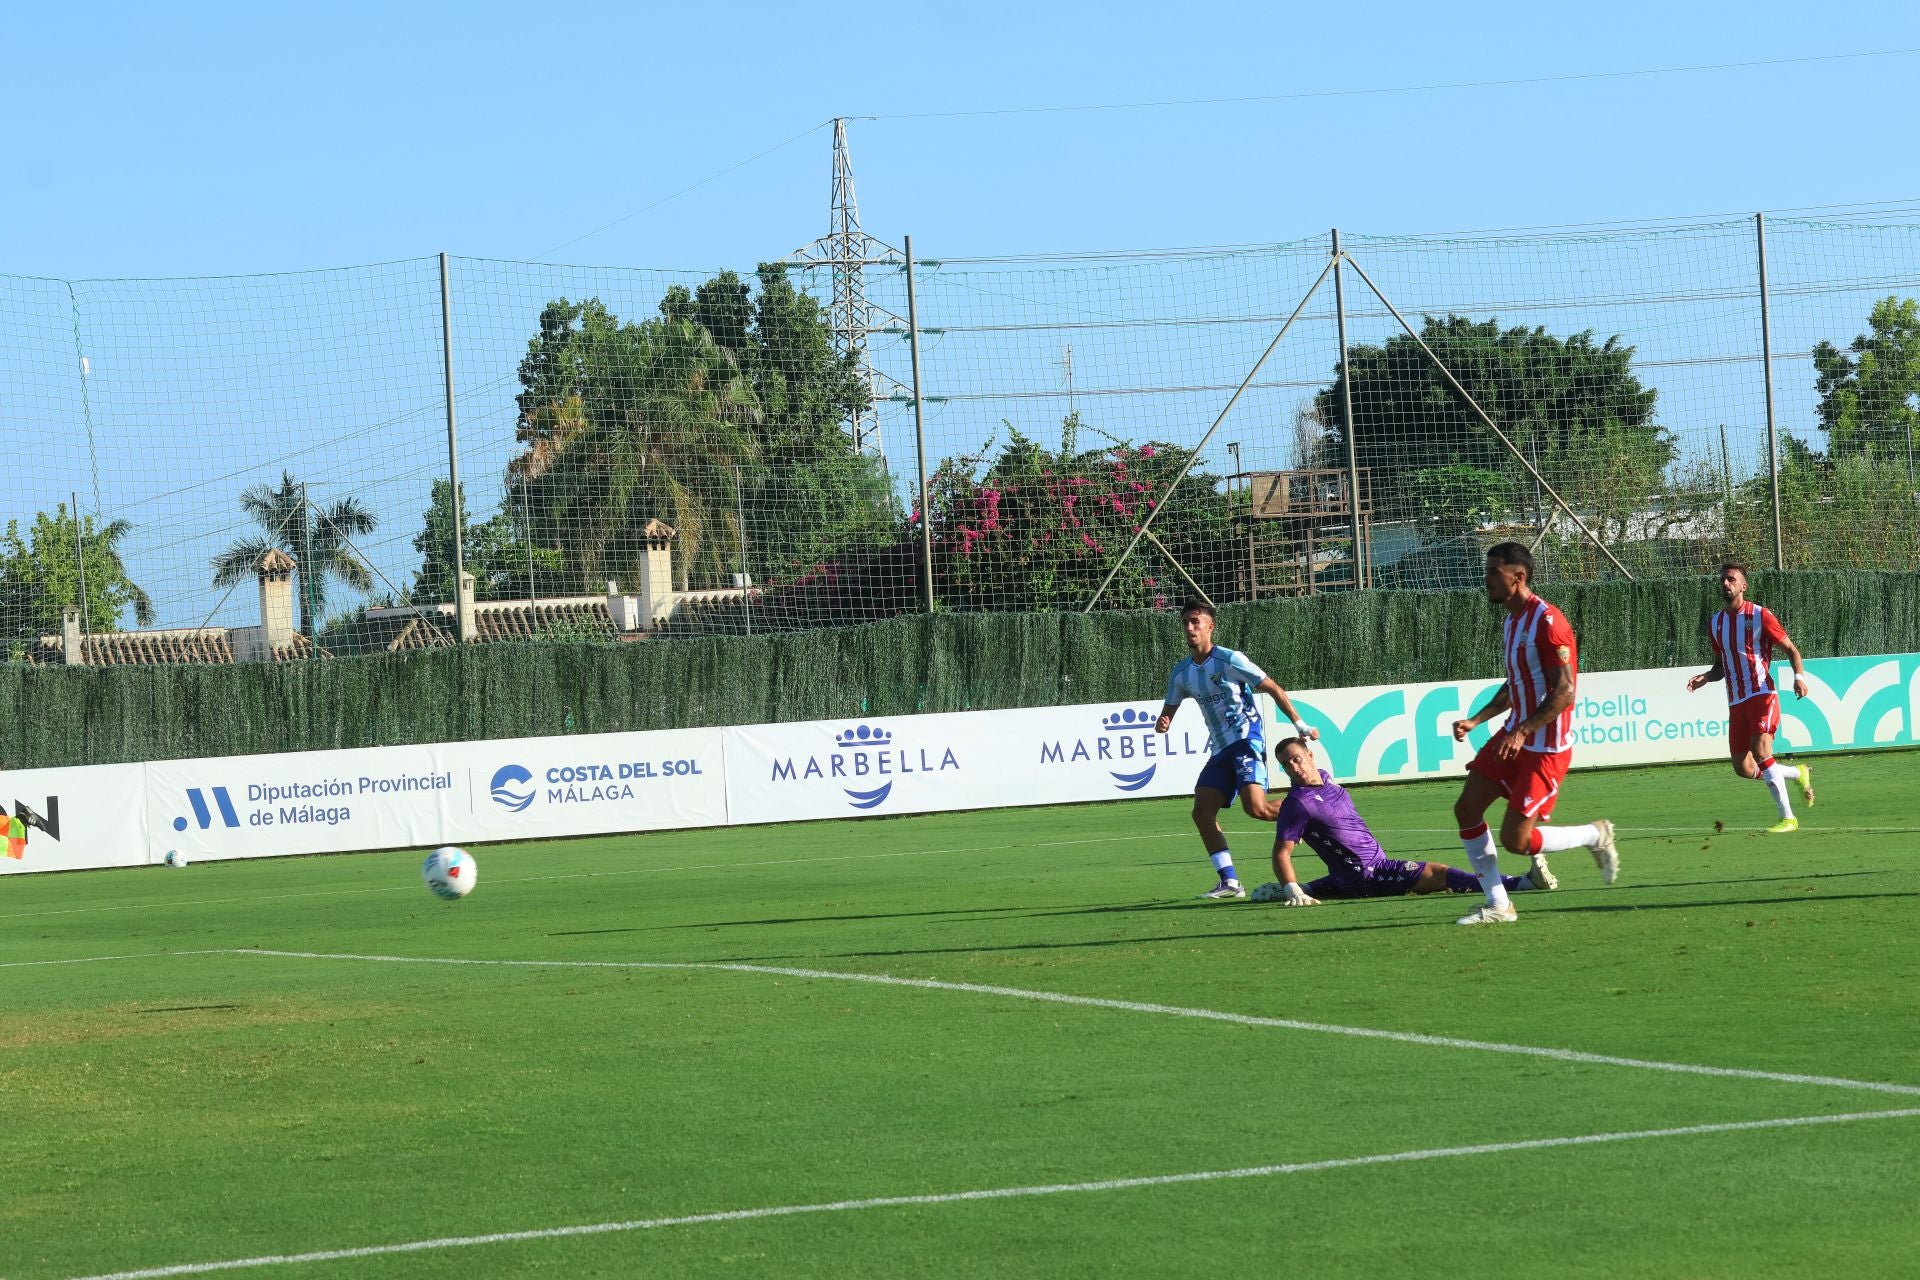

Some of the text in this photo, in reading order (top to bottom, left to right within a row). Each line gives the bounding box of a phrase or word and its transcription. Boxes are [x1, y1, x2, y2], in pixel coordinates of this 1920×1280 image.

[1645, 719, 1729, 740] Center
[546, 759, 702, 783] COSTA DEL SOL
[771, 747, 960, 781] MARBELLA
[248, 771, 451, 804] Diputación Provincial
[547, 784, 635, 804] MÁLAGA
[249, 804, 351, 826] de Málaga
